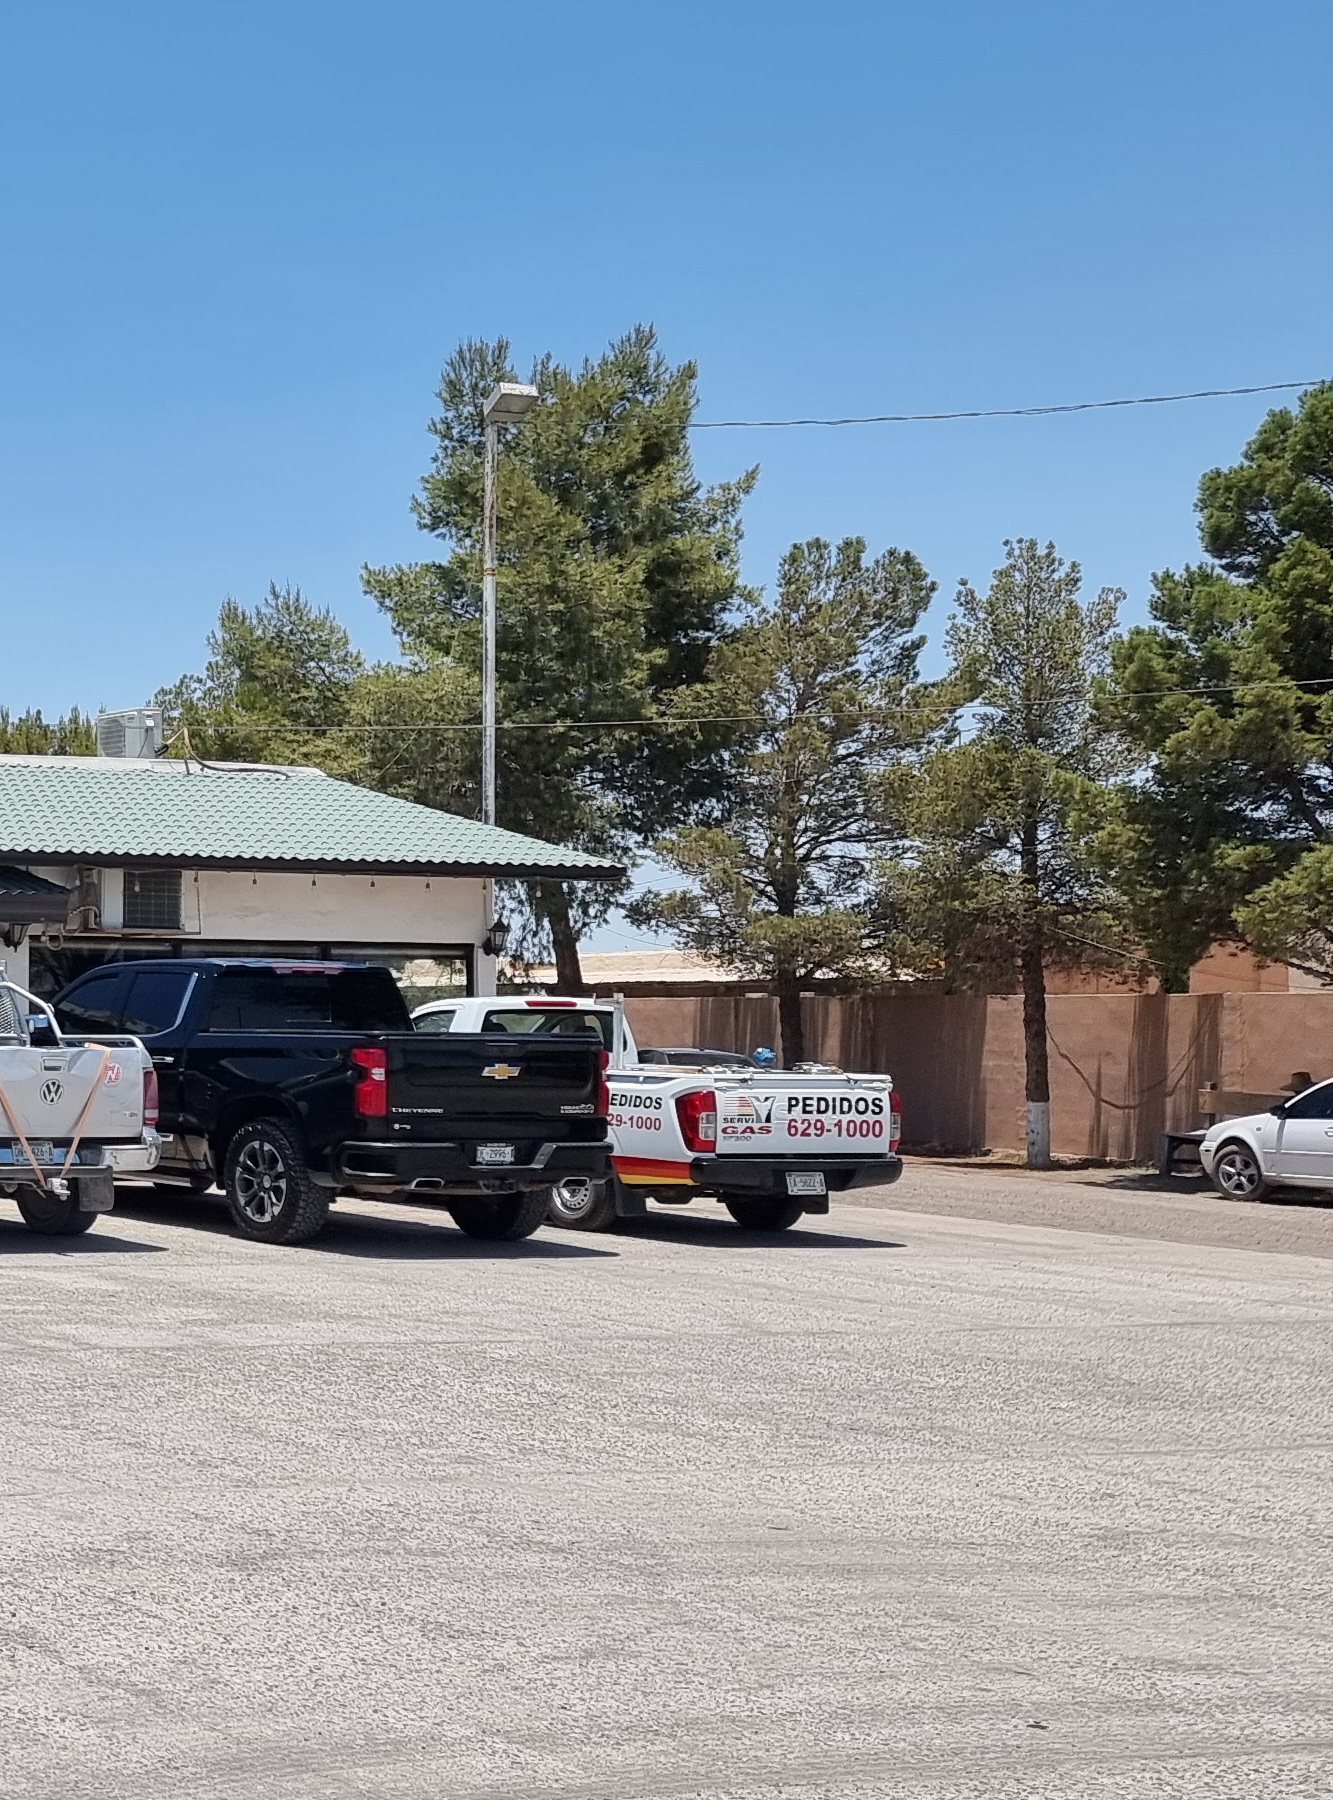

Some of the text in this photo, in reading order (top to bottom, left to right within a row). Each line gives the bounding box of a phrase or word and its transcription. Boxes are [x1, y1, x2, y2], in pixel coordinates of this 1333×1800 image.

[787, 1096, 884, 1116] PEDIDOS
[721, 1125, 773, 1135] GAS
[786, 1118, 884, 1138] 629-1000
